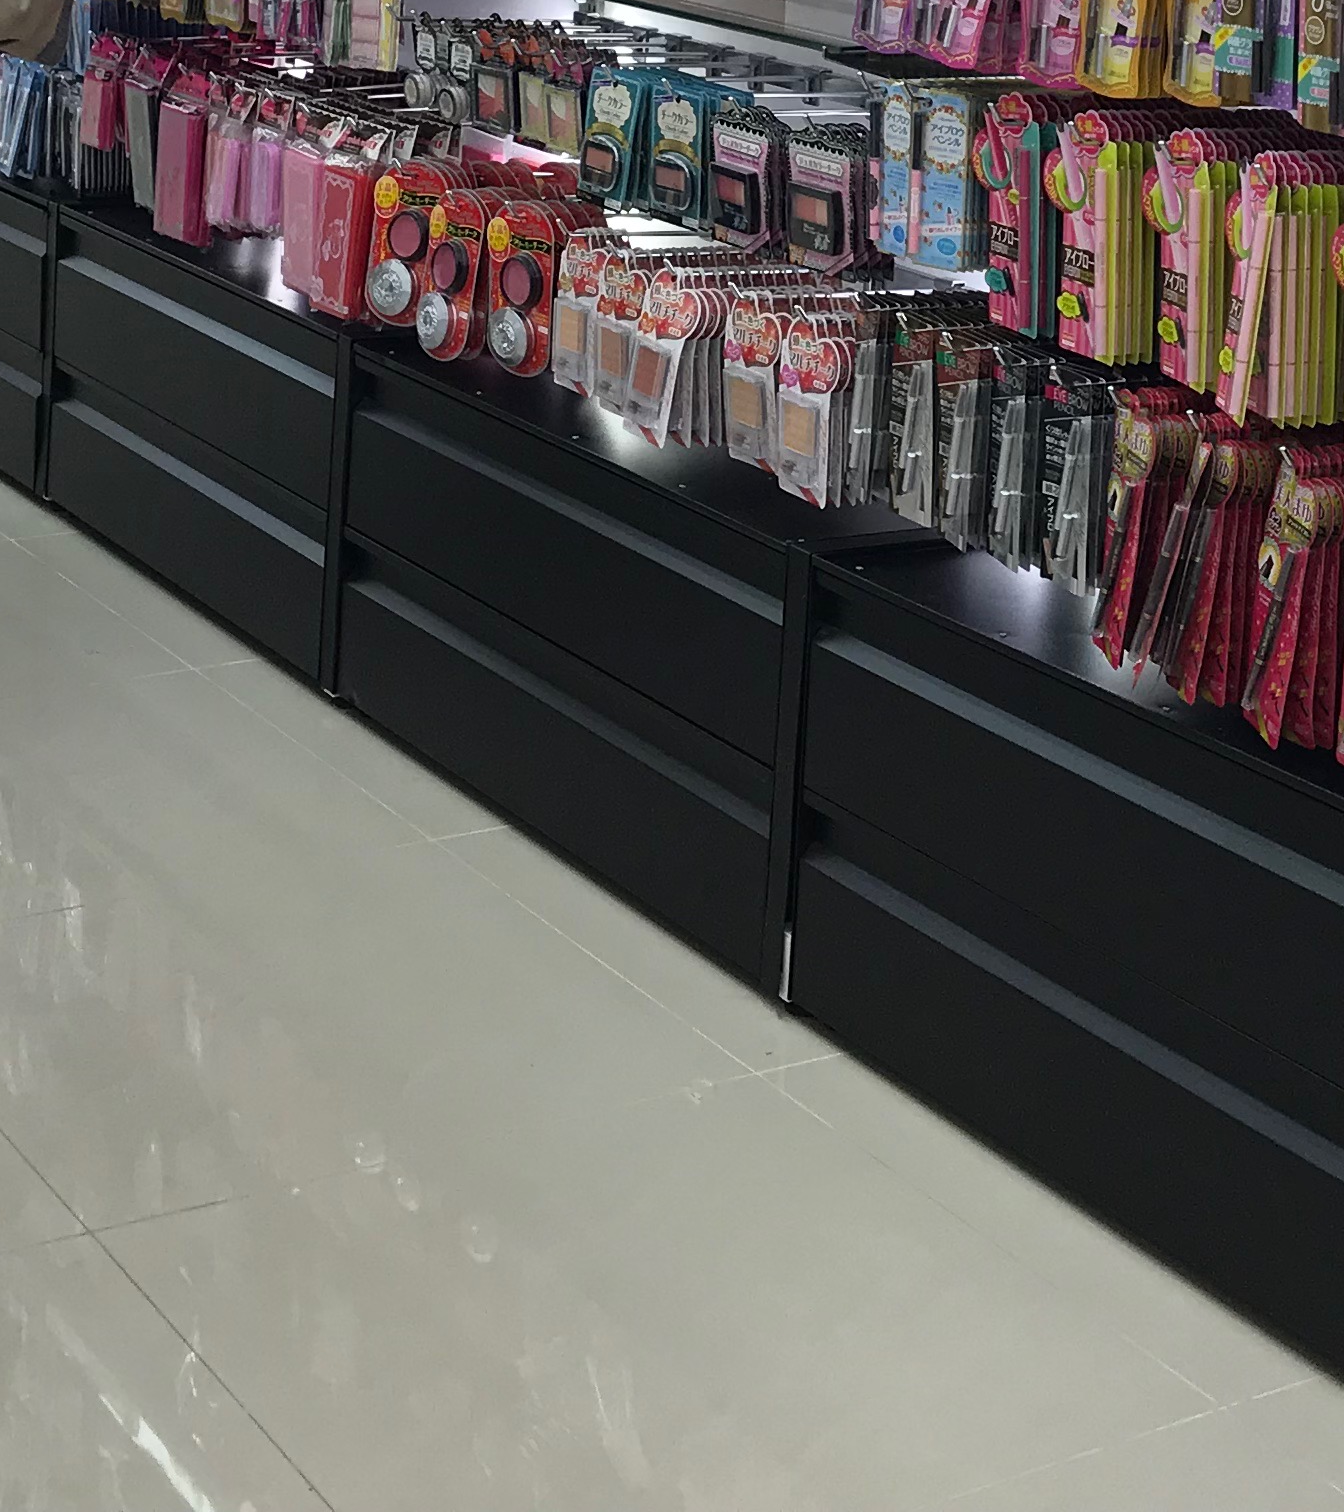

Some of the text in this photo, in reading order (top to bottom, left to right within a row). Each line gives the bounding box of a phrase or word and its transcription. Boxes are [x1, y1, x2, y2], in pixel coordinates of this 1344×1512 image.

[930, 122, 965, 137] アイブロウ
[932, 134, 963, 148] ペンシル
[566, 259, 600, 280] マルチチー
[1063, 246, 1095, 272] アイブロー
[649, 300, 695, 327] マルチチーク
[732, 328, 778, 356] マルチチーク
[789, 352, 836, 380] マルチチーク
